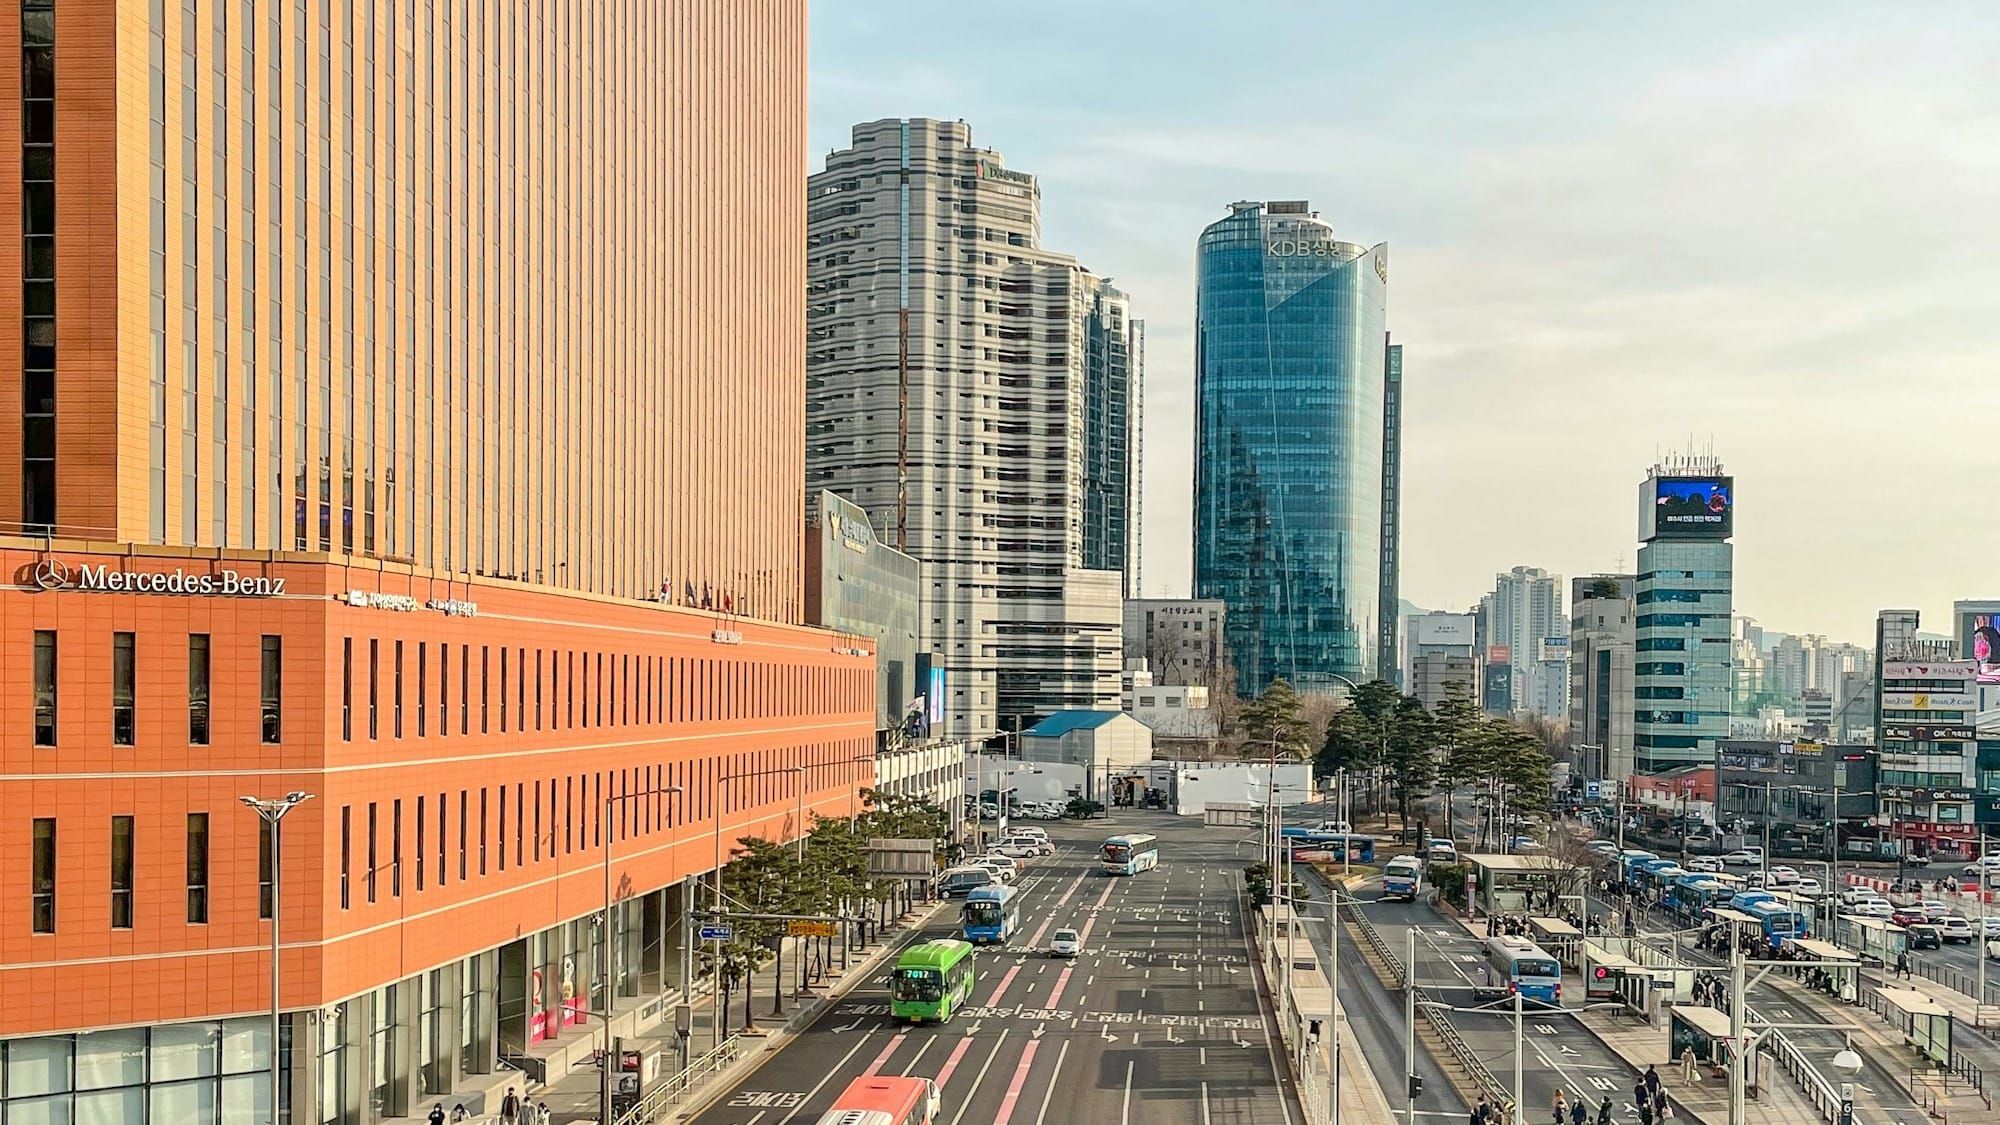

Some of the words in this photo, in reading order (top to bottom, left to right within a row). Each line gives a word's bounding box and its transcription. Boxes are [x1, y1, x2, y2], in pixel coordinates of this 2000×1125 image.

[78, 563, 286, 596] Mercedes-Benz
[906, 969, 929, 978] 7017
[727, 1090, 807, 1109] 퇴계로
[1843, 1102, 1852, 1113] 6
